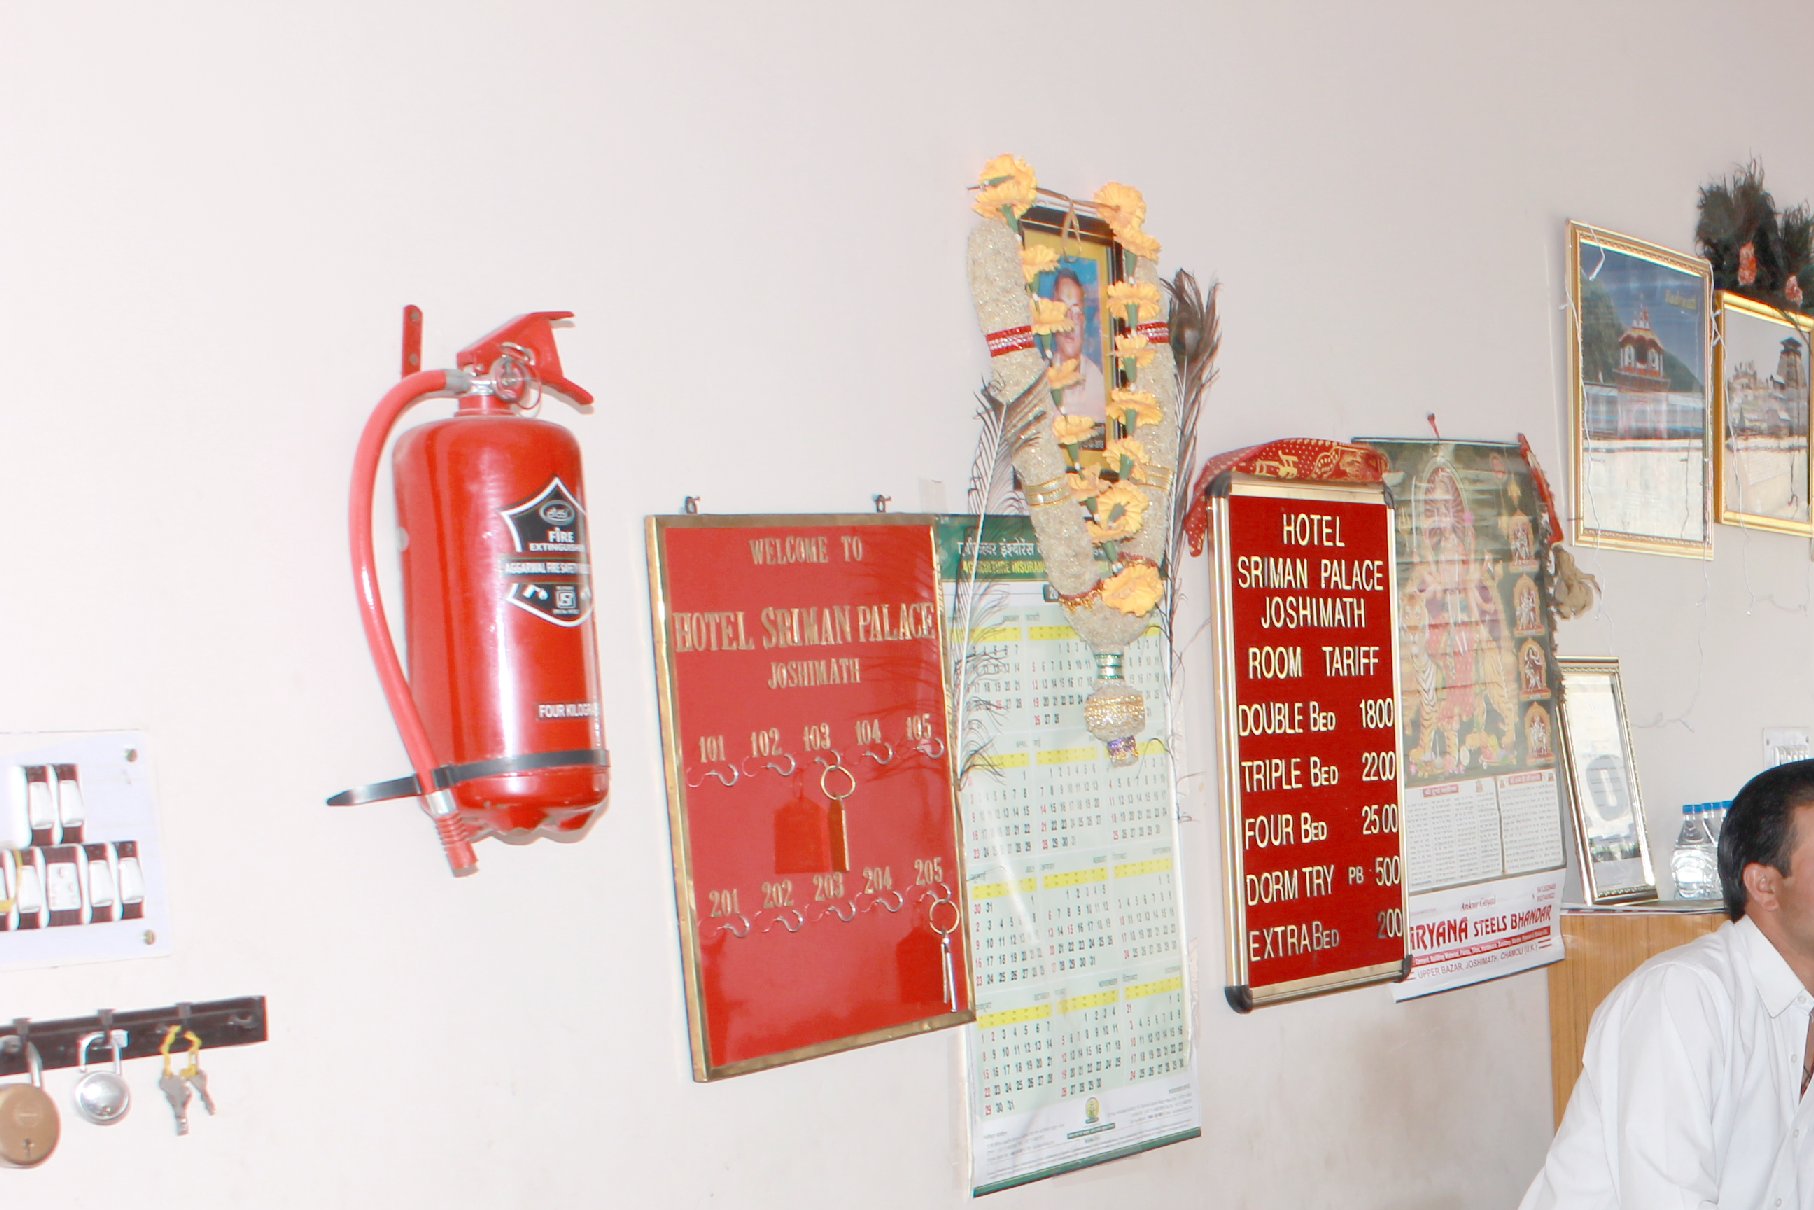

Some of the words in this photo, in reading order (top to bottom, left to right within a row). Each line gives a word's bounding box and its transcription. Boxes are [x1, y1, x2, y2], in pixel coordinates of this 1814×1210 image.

[547, 525, 575, 543] FIRE
[1282, 513, 1345, 547] HOTEL
[749, 536, 828, 565] WELCOME
[842, 535, 863, 561] TO
[1237, 556, 1308, 589] SRIMAN
[1320, 559, 1384, 591] PALACE
[672, 611, 755, 652] HOTEL
[761, 605, 851, 649] SRIMAN
[858, 602, 936, 642] PALACE
[1261, 596, 1366, 628] JOSHIMATH
[768, 658, 861, 690] JOSHIMATH
[1248, 646, 1302, 679] ROOM
[1322, 646, 1379, 677] TARIFF
[538, 704, 565, 718] FOUR
[1238, 702, 1304, 736] DOUBLE
[1359, 698, 1394, 729] 1800
[698, 736, 726, 764] 101
[750, 728, 782, 757] 102
[803, 723, 832, 752] 103
[855, 718, 882, 747] 104
[1241, 758, 1303, 792] TRIPLE
[1361, 751, 1396, 782] 2200
[1245, 814, 1294, 850] FOUR
[1375, 855, 1401, 886] 500
[708, 889, 740, 918] 201
[761, 880, 793, 909] 202
[812, 872, 845, 901] 203
[863, 866, 892, 895] 204
[914, 857, 943, 885] 205
[1377, 908, 1404, 939] 200
[1473, 915, 1507, 937] STEELS
[1510, 905, 1552, 930] BHANDAR
